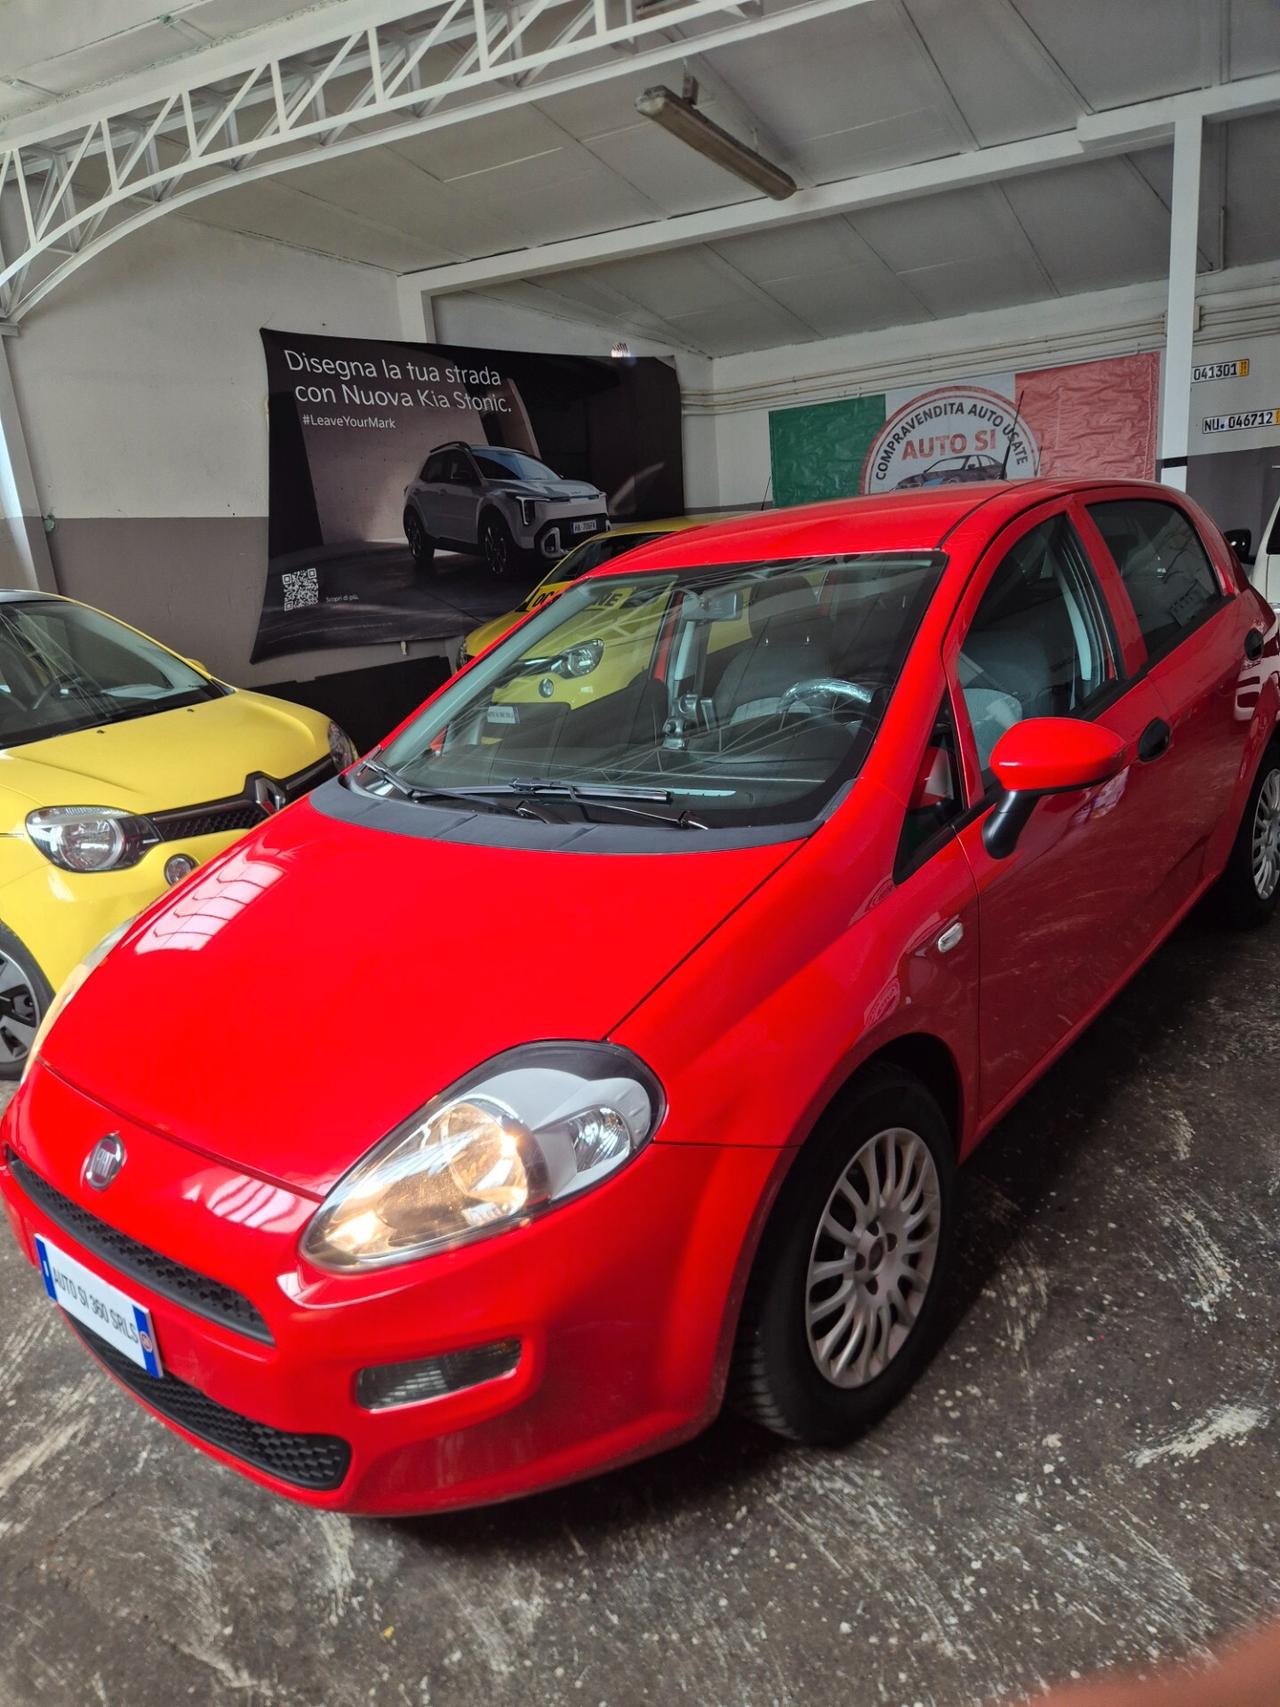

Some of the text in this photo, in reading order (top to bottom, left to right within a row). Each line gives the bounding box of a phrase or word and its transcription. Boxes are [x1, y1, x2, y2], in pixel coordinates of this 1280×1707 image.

[284, 349, 502, 386] Disegna la tua strada
[1193, 363, 1238, 381] 041301
[295, 383, 512, 412] con Nuova Kia Stonic.
[302, 414, 396, 429] #LeaveYourMark
[875, 401, 1029, 481] COMPRAVENDITA AUTO USATE
[902, 433, 968, 460] AUTO
[53, 1266, 77, 1300] AUTO
[78, 1286, 90, 1309] SI
[110, 1309, 139, 1344] SRLS
